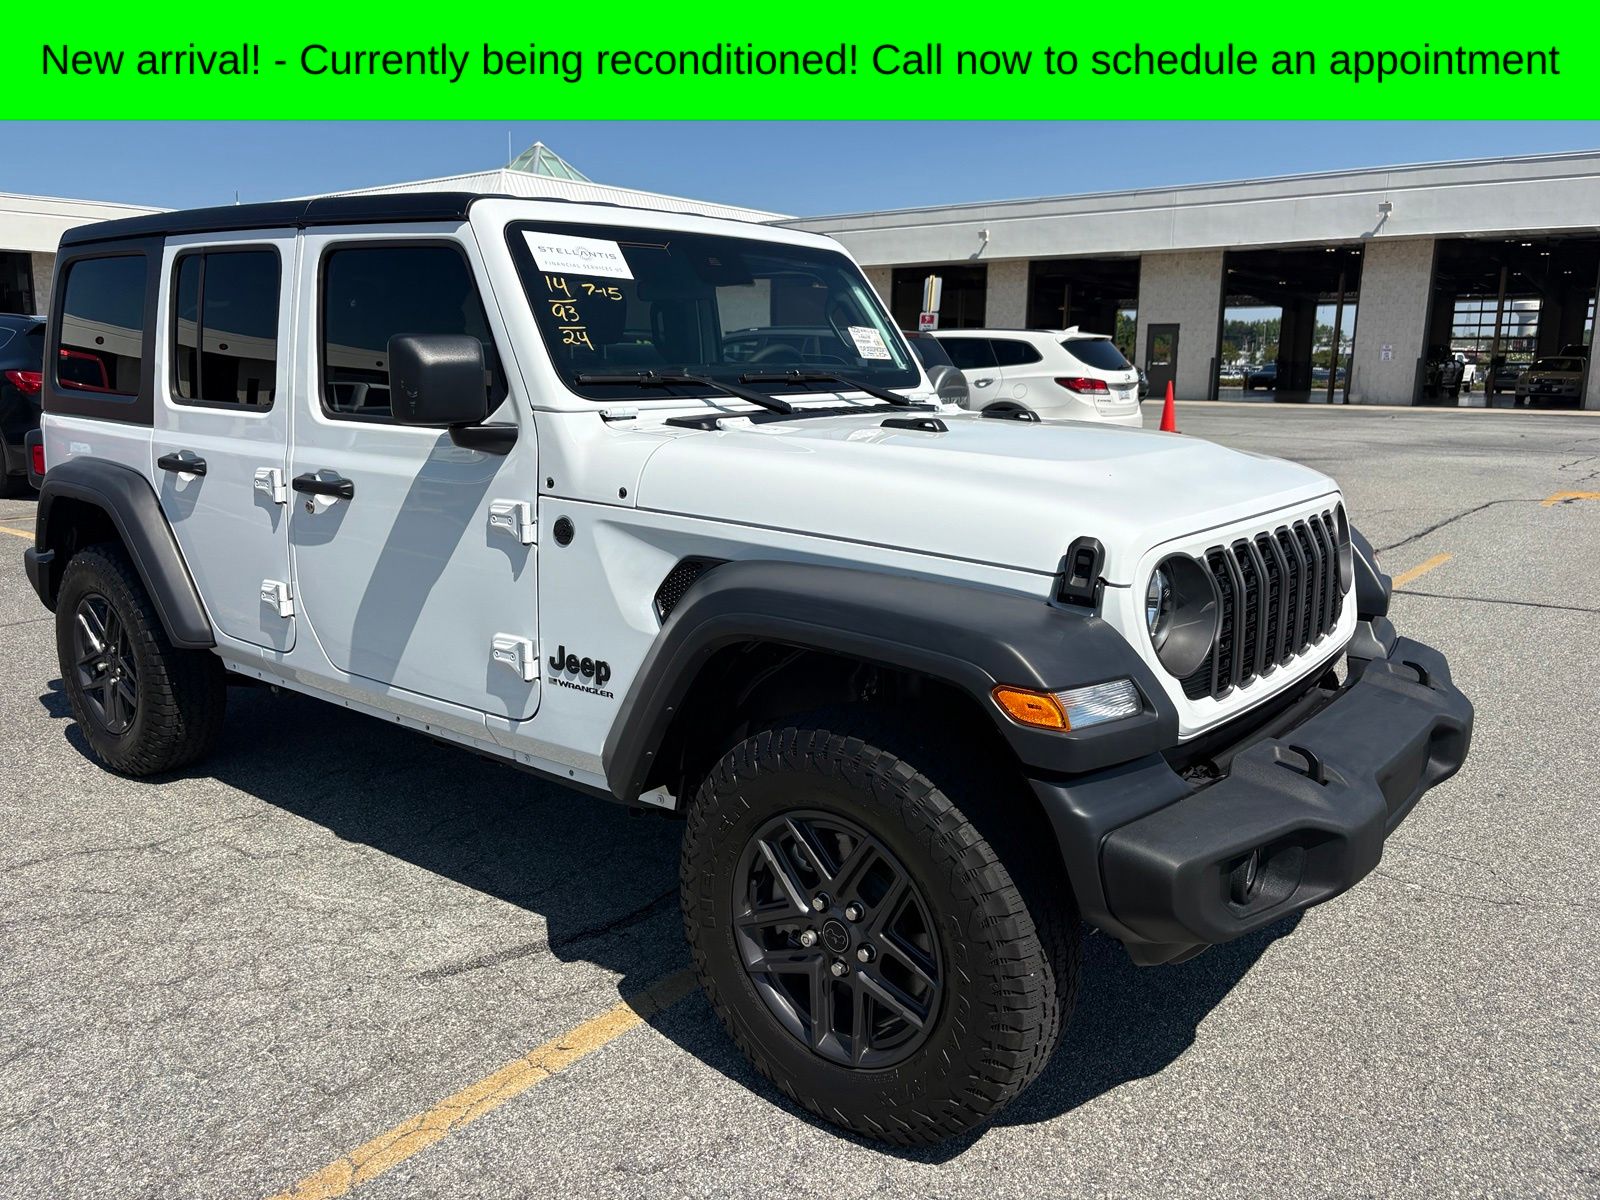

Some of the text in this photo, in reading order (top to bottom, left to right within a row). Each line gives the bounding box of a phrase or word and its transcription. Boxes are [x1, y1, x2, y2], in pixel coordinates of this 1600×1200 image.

[538, 245, 617, 260] STELLANTIS
[544, 260, 581, 270] FINANCIAL
[582, 263, 613, 272] SERVICES
[545, 275, 571, 298] 14
[581, 283, 623, 301] 7-15
[551, 303, 580, 322] 93
[562, 329, 595, 351] 24
[549, 644, 611, 686] Jeep
[558, 679, 614, 699] WRANGLER
